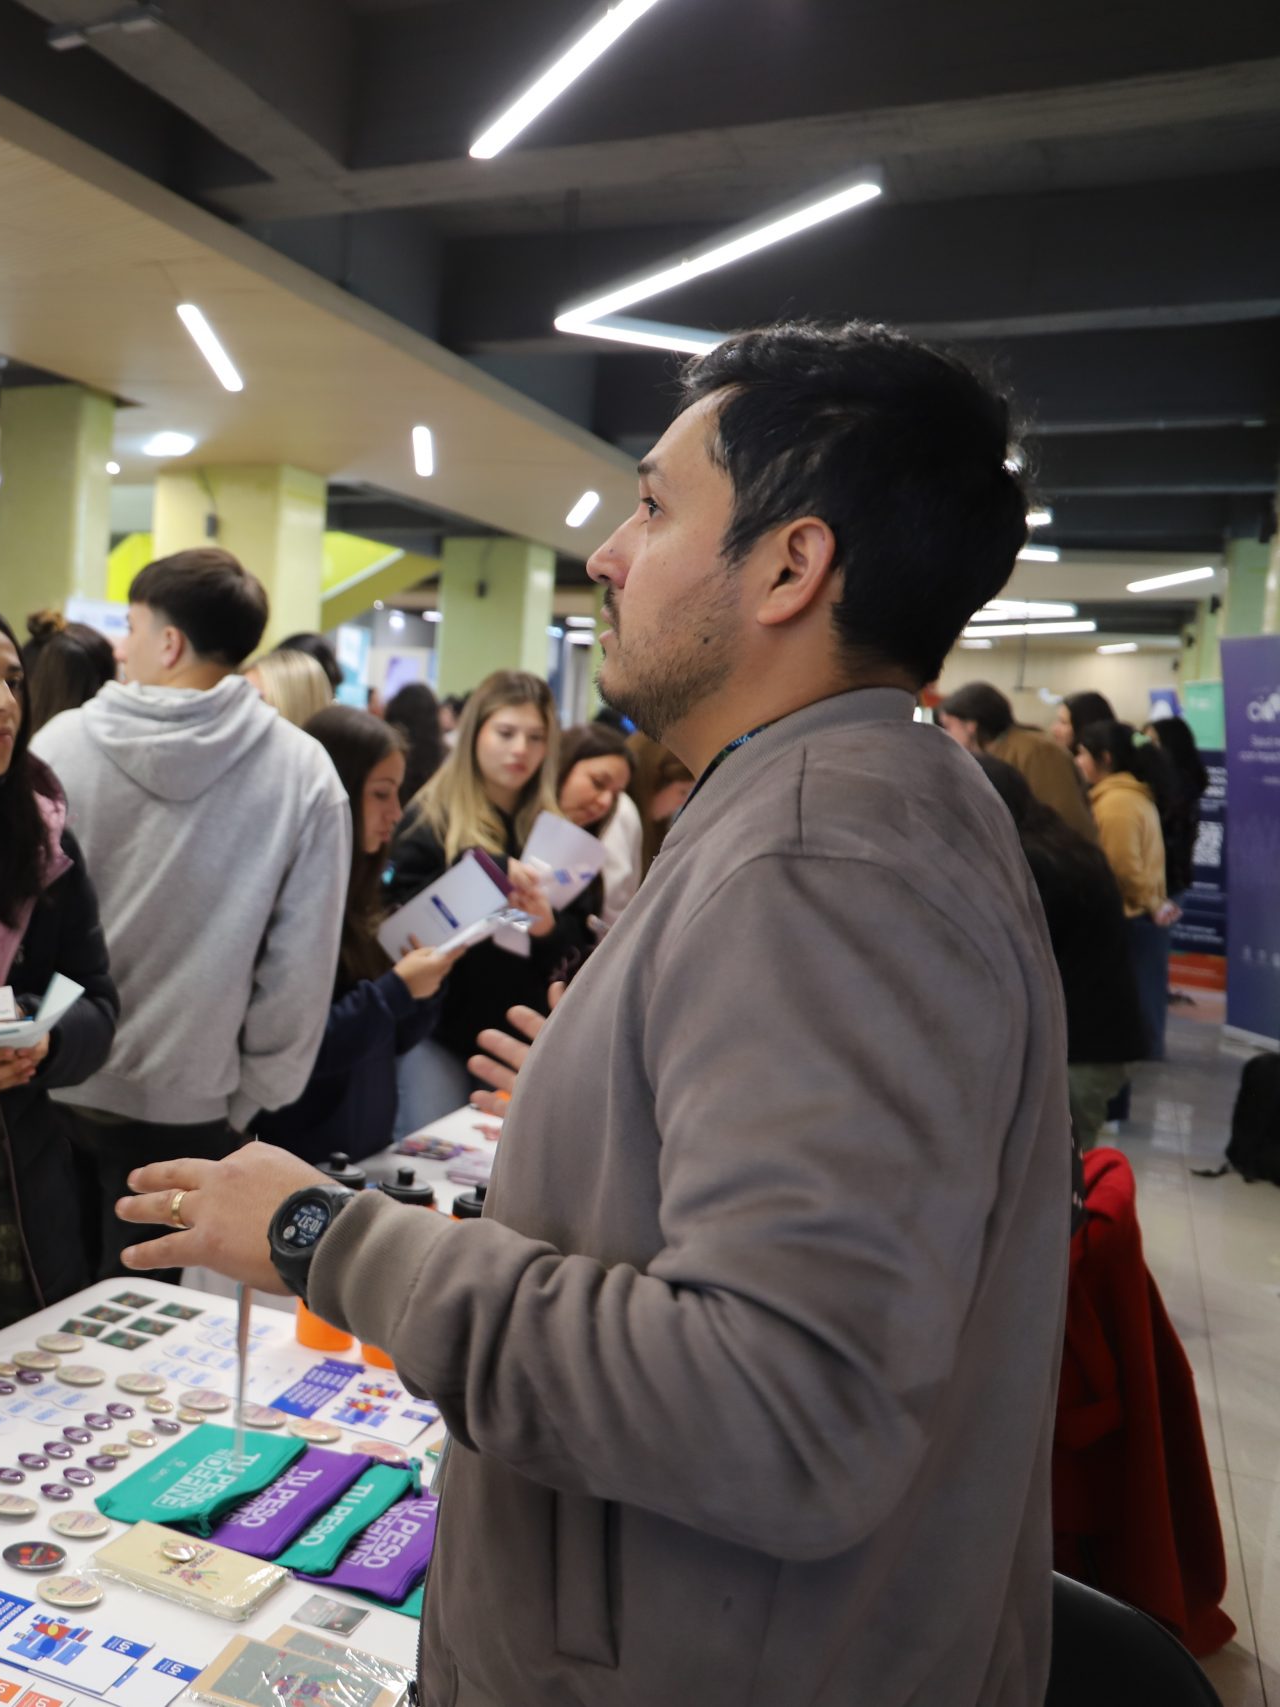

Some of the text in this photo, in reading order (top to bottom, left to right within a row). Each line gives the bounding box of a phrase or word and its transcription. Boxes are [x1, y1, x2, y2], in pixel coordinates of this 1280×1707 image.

[227, 1451, 262, 1474] TU
[288, 1468, 323, 1489] TU
[240, 1488, 300, 1528] PESO
[299, 1505, 354, 1546] PESO
[362, 1521, 422, 1569] PESO
